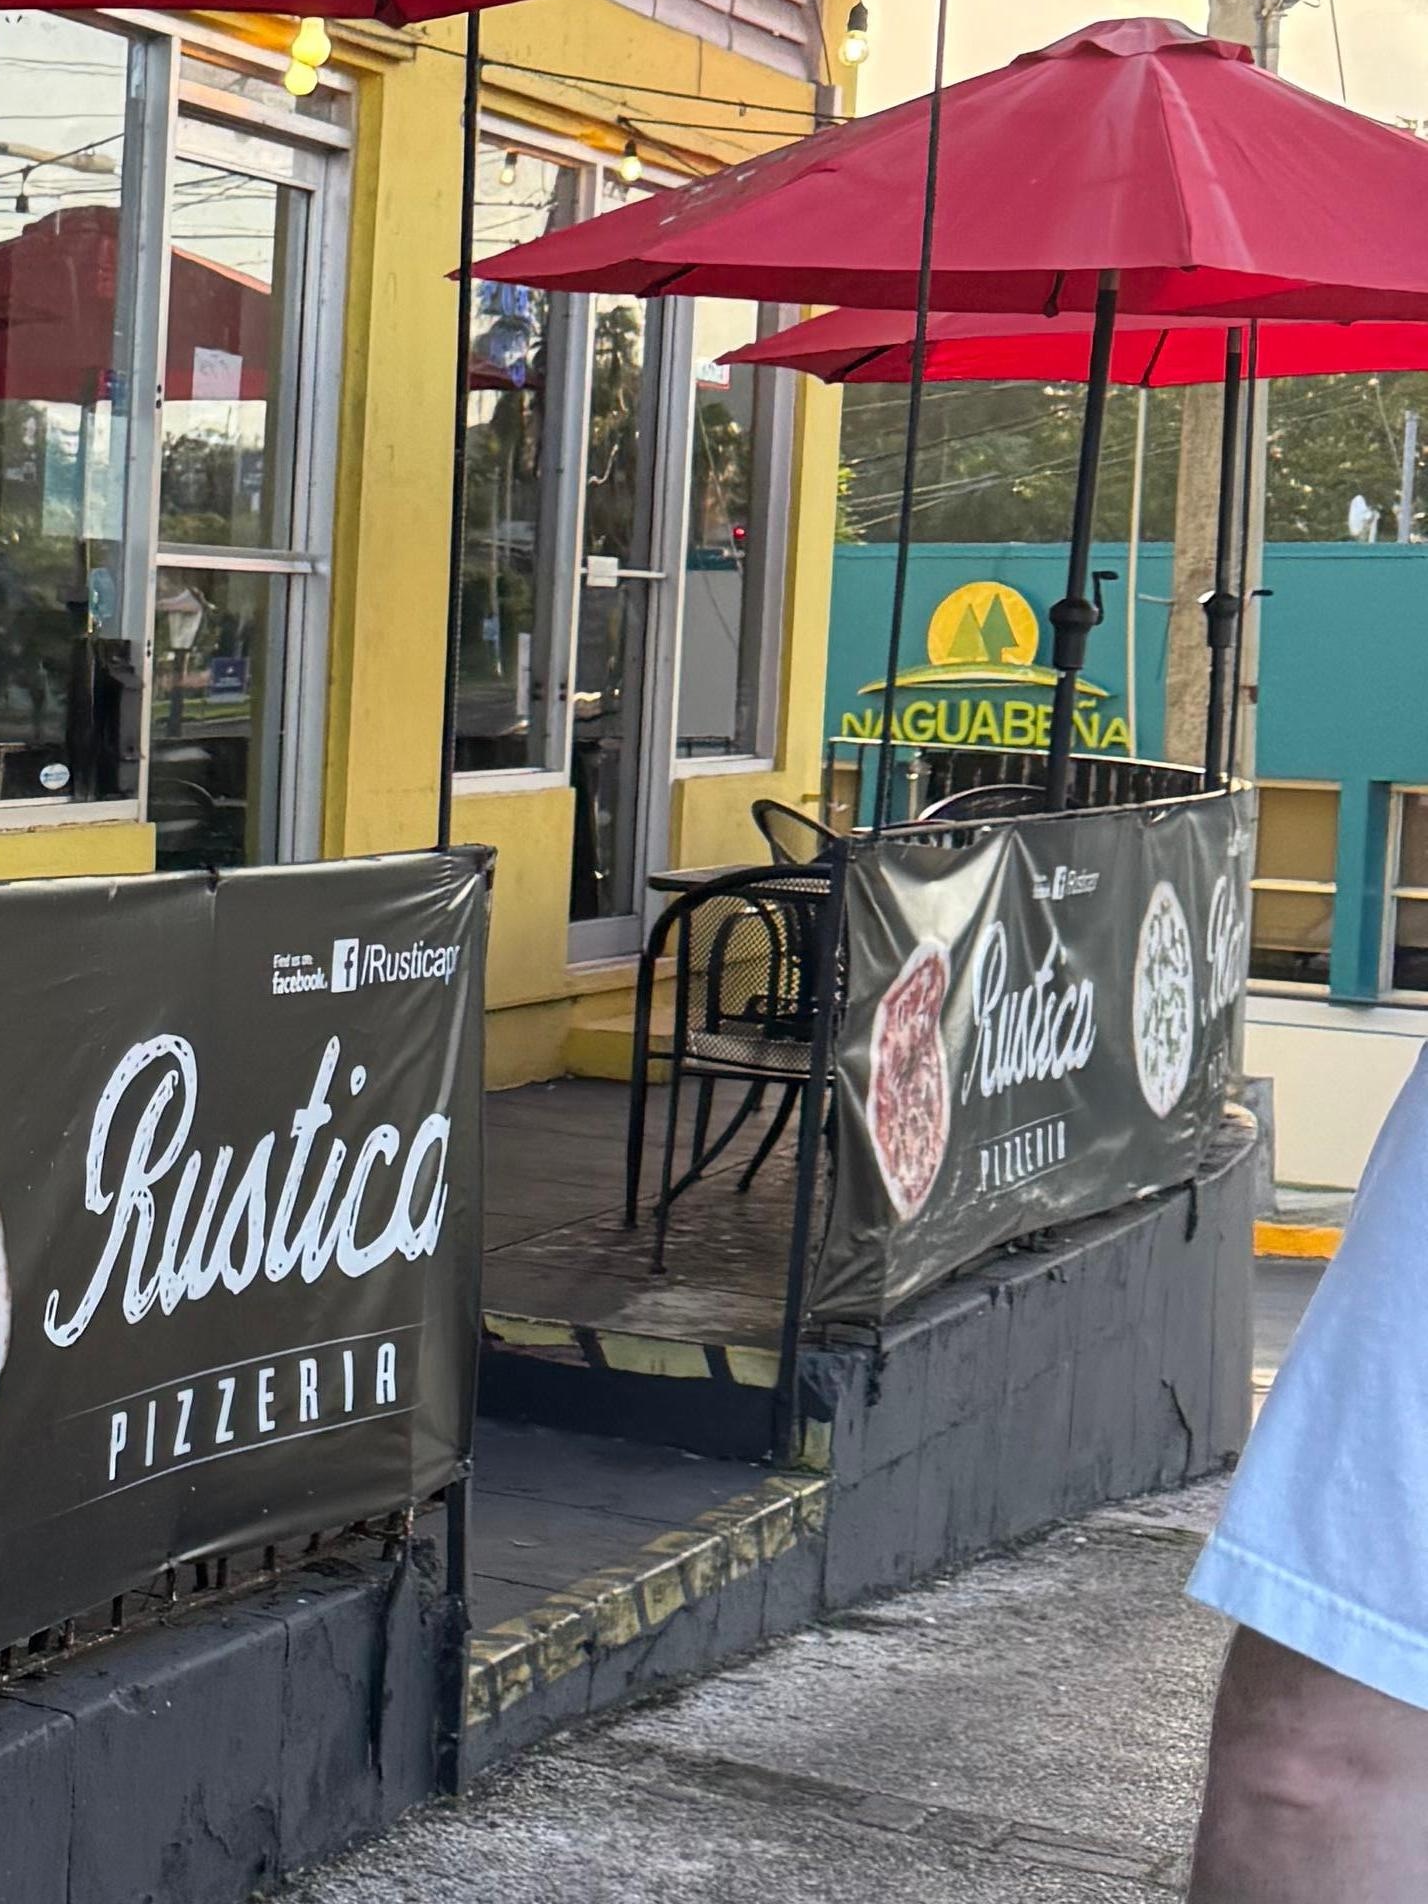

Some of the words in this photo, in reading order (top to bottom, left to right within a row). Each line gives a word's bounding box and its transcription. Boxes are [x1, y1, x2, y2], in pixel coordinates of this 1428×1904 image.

[960, 920, 1097, 1106] Rustica
[44, 1033, 451, 1348] Rustica
[107, 1342, 397, 1481] PIZZERIA
